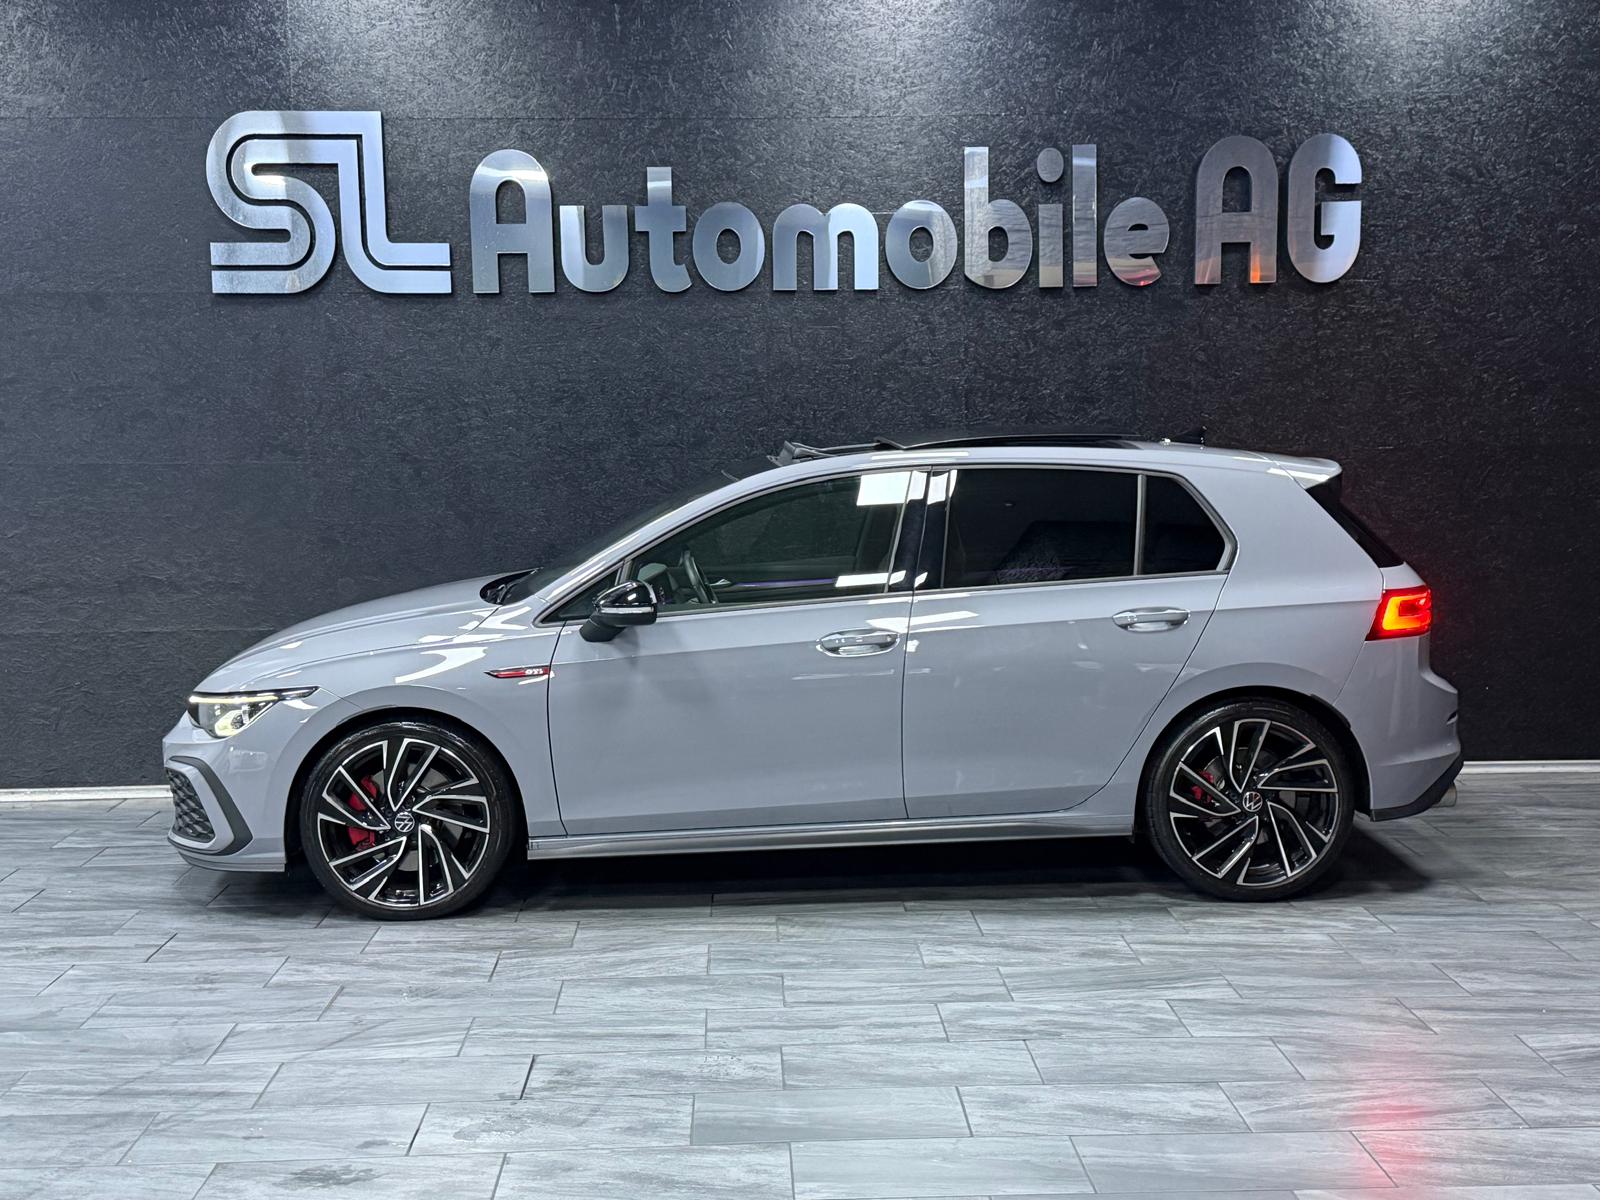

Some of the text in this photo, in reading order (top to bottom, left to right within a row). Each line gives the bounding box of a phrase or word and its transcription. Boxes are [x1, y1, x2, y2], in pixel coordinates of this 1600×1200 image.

[206, 110, 1362, 294] SL Automobile AG
